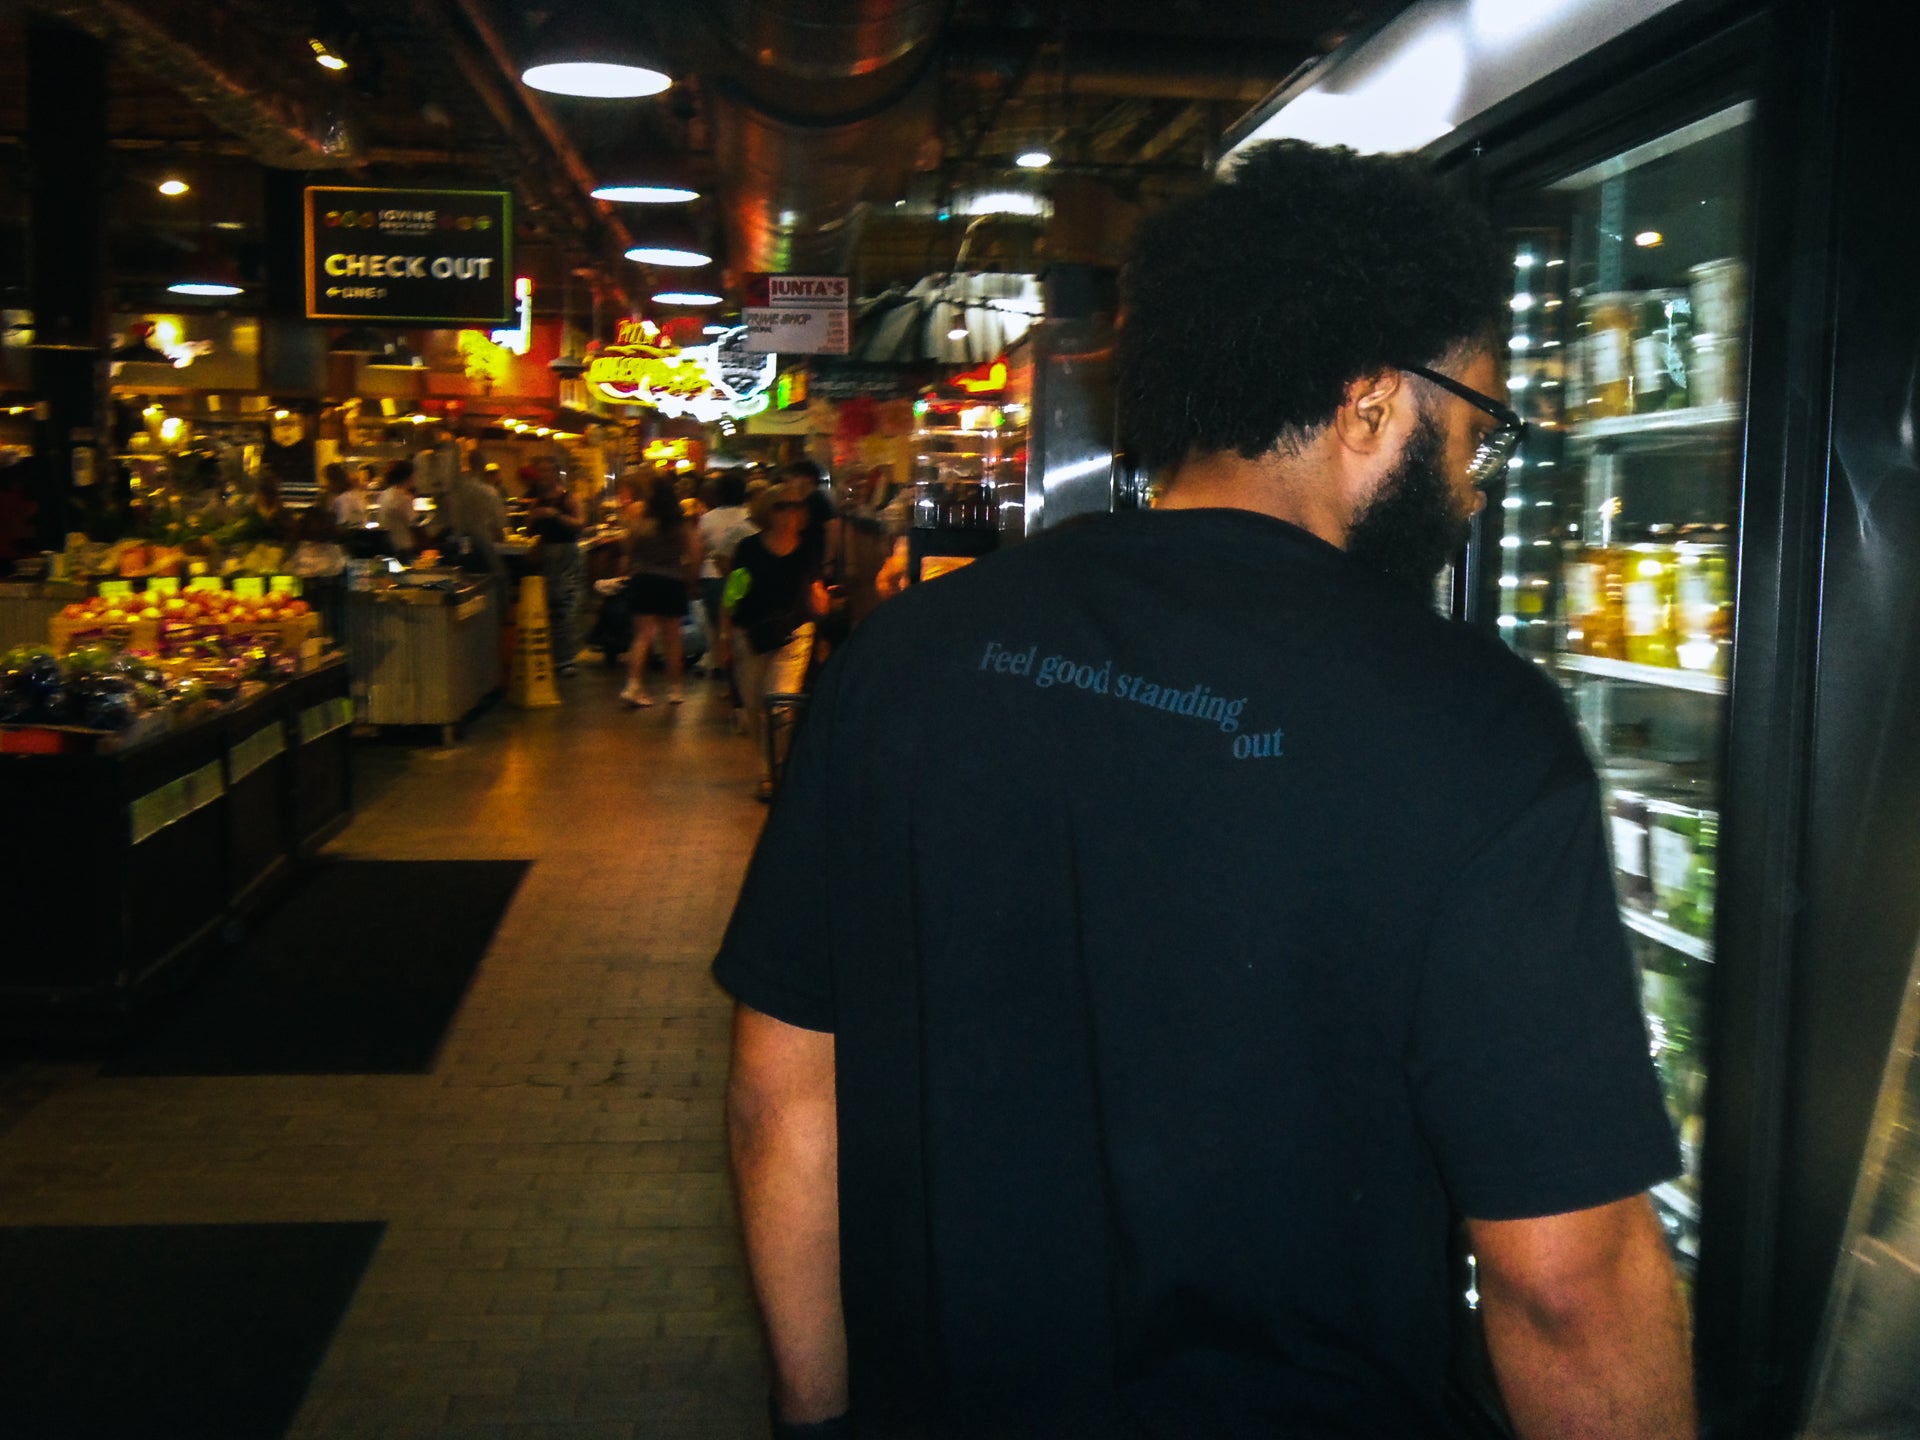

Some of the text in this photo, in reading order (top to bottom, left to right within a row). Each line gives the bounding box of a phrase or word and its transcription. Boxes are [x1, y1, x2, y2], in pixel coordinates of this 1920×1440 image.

[324, 253, 494, 280] CHECK OUT
[751, 280, 845, 297] IUNTA'S
[781, 313, 812, 325] SHOP
[979, 641, 1248, 733] Feel good standing
[1232, 727, 1285, 760] out
